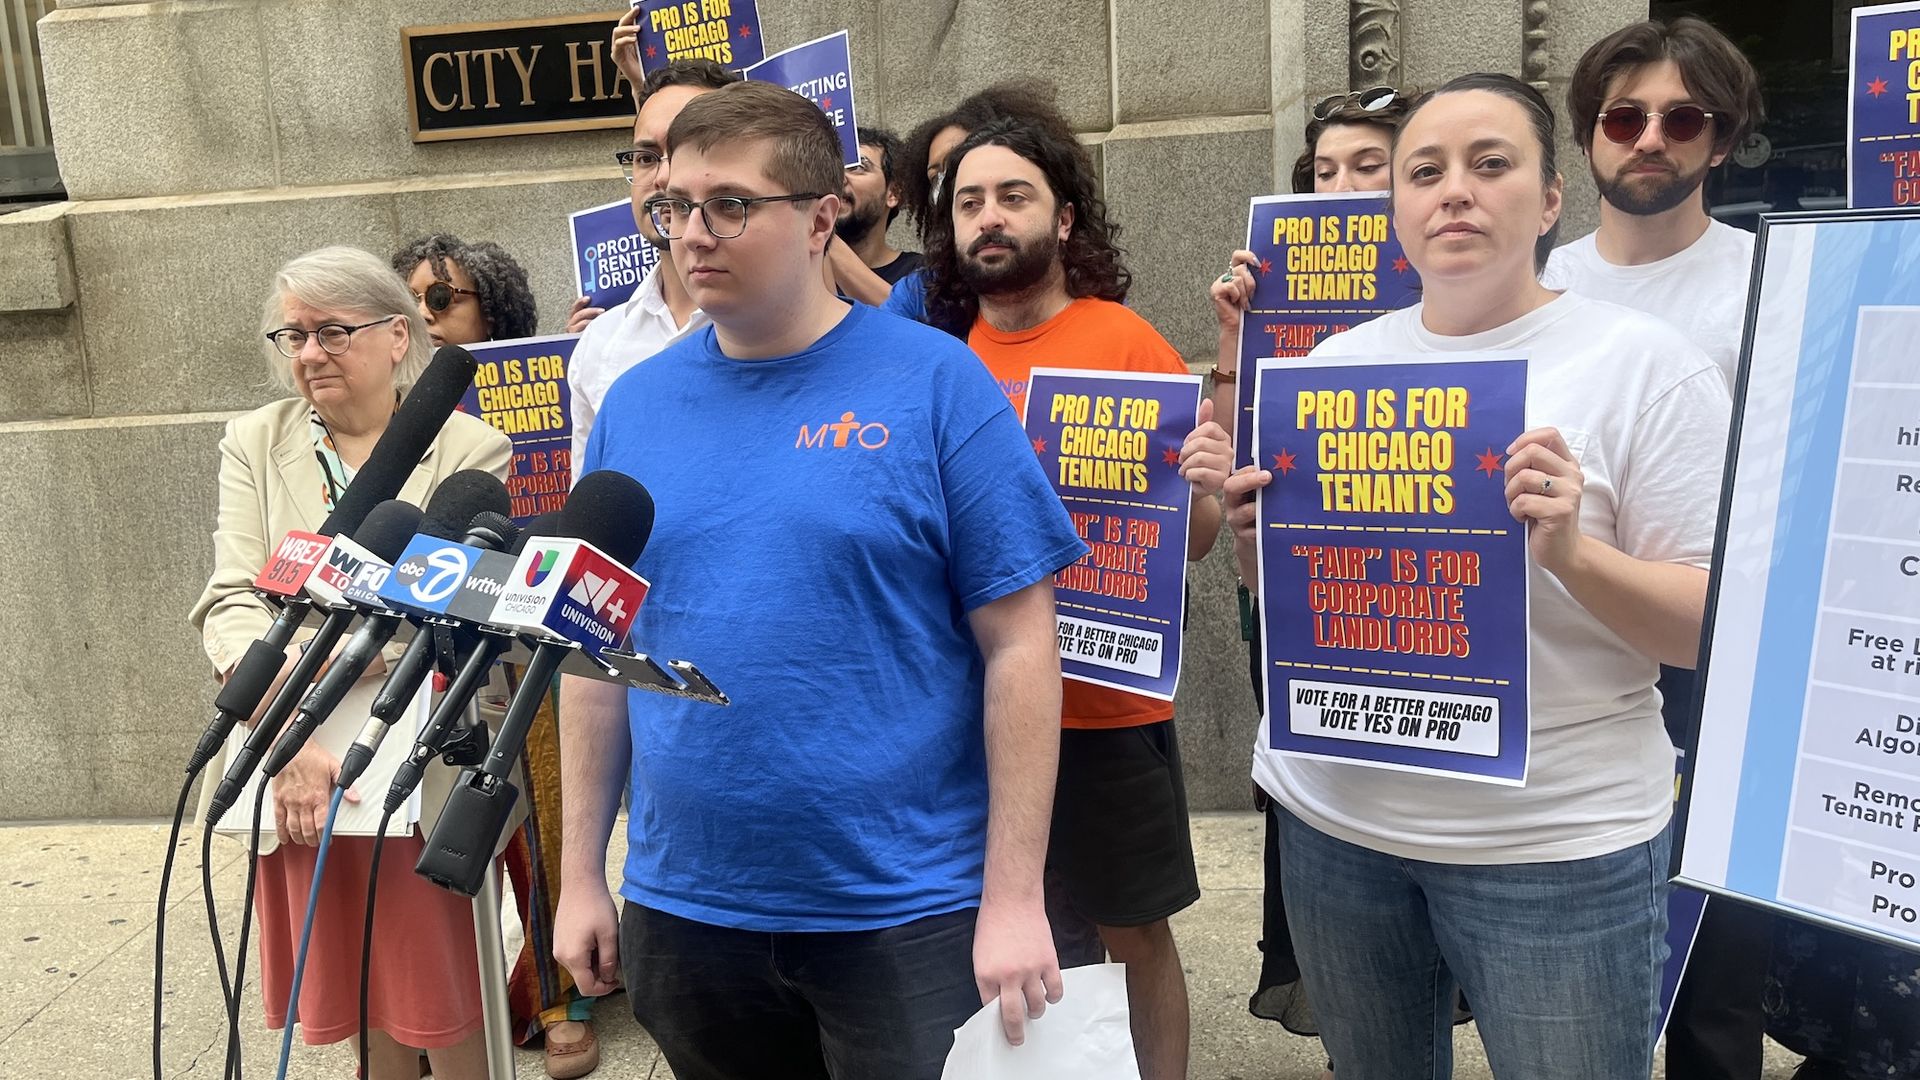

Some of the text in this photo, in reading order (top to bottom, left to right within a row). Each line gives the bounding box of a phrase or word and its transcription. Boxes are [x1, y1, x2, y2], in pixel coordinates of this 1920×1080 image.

[650, 0, 731, 32] PRO IS FOR
[664, 19, 729, 52] CHICAGO
[422, 45, 543, 112] CITY
[1273, 214, 1388, 246] PRO IS FOR
[1286, 244, 1378, 273] CHICAGO
[1286, 273, 1377, 301] TENANTS
[503, 359, 523, 384] IS
[527, 355, 564, 382] FOR
[478, 381, 559, 412] CHICAGO
[1050, 393, 1160, 430] PRO IS FOR
[1297, 387, 1469, 430] PRO IS FOR
[1060, 425, 1148, 462] CHICAGO
[1318, 430, 1454, 471] CHICAGO
[530, 451, 548, 473] IS
[1058, 456, 1148, 493] TENANTS
[1317, 473, 1455, 515] TENANTS
[1104, 515, 1122, 543] IS
[1126, 518, 1160, 548] FOR
[277, 536, 327, 565] WBEZ
[1291, 545, 1480, 587] “FAIR” IS FOR
[268, 559, 303, 584] 91.5
[399, 561, 426, 577] abc
[465, 576, 505, 597] wttw
[1308, 580, 1465, 622] CORPORATE
[561, 603, 616, 645] UNIVISION
[1058, 621, 1158, 652] FOR A BETTER CHICAGO
[1313, 615, 1470, 659] LANDLORDS
[1077, 638, 1096, 657] YES
[1098, 644, 1114, 659] ON
[1115, 647, 1138, 665] PRO
[1848, 628, 1904, 653] Free
[1871, 654, 1896, 671] at
[1296, 688, 1493, 723] VOTE FOR A BETTER CHICAGO
[1320, 708, 1461, 742] VOTE YES ON PRO
[1822, 794, 1904, 829] Tenant
[1870, 860, 1915, 889] Pro
[1872, 894, 1917, 923] Pro
